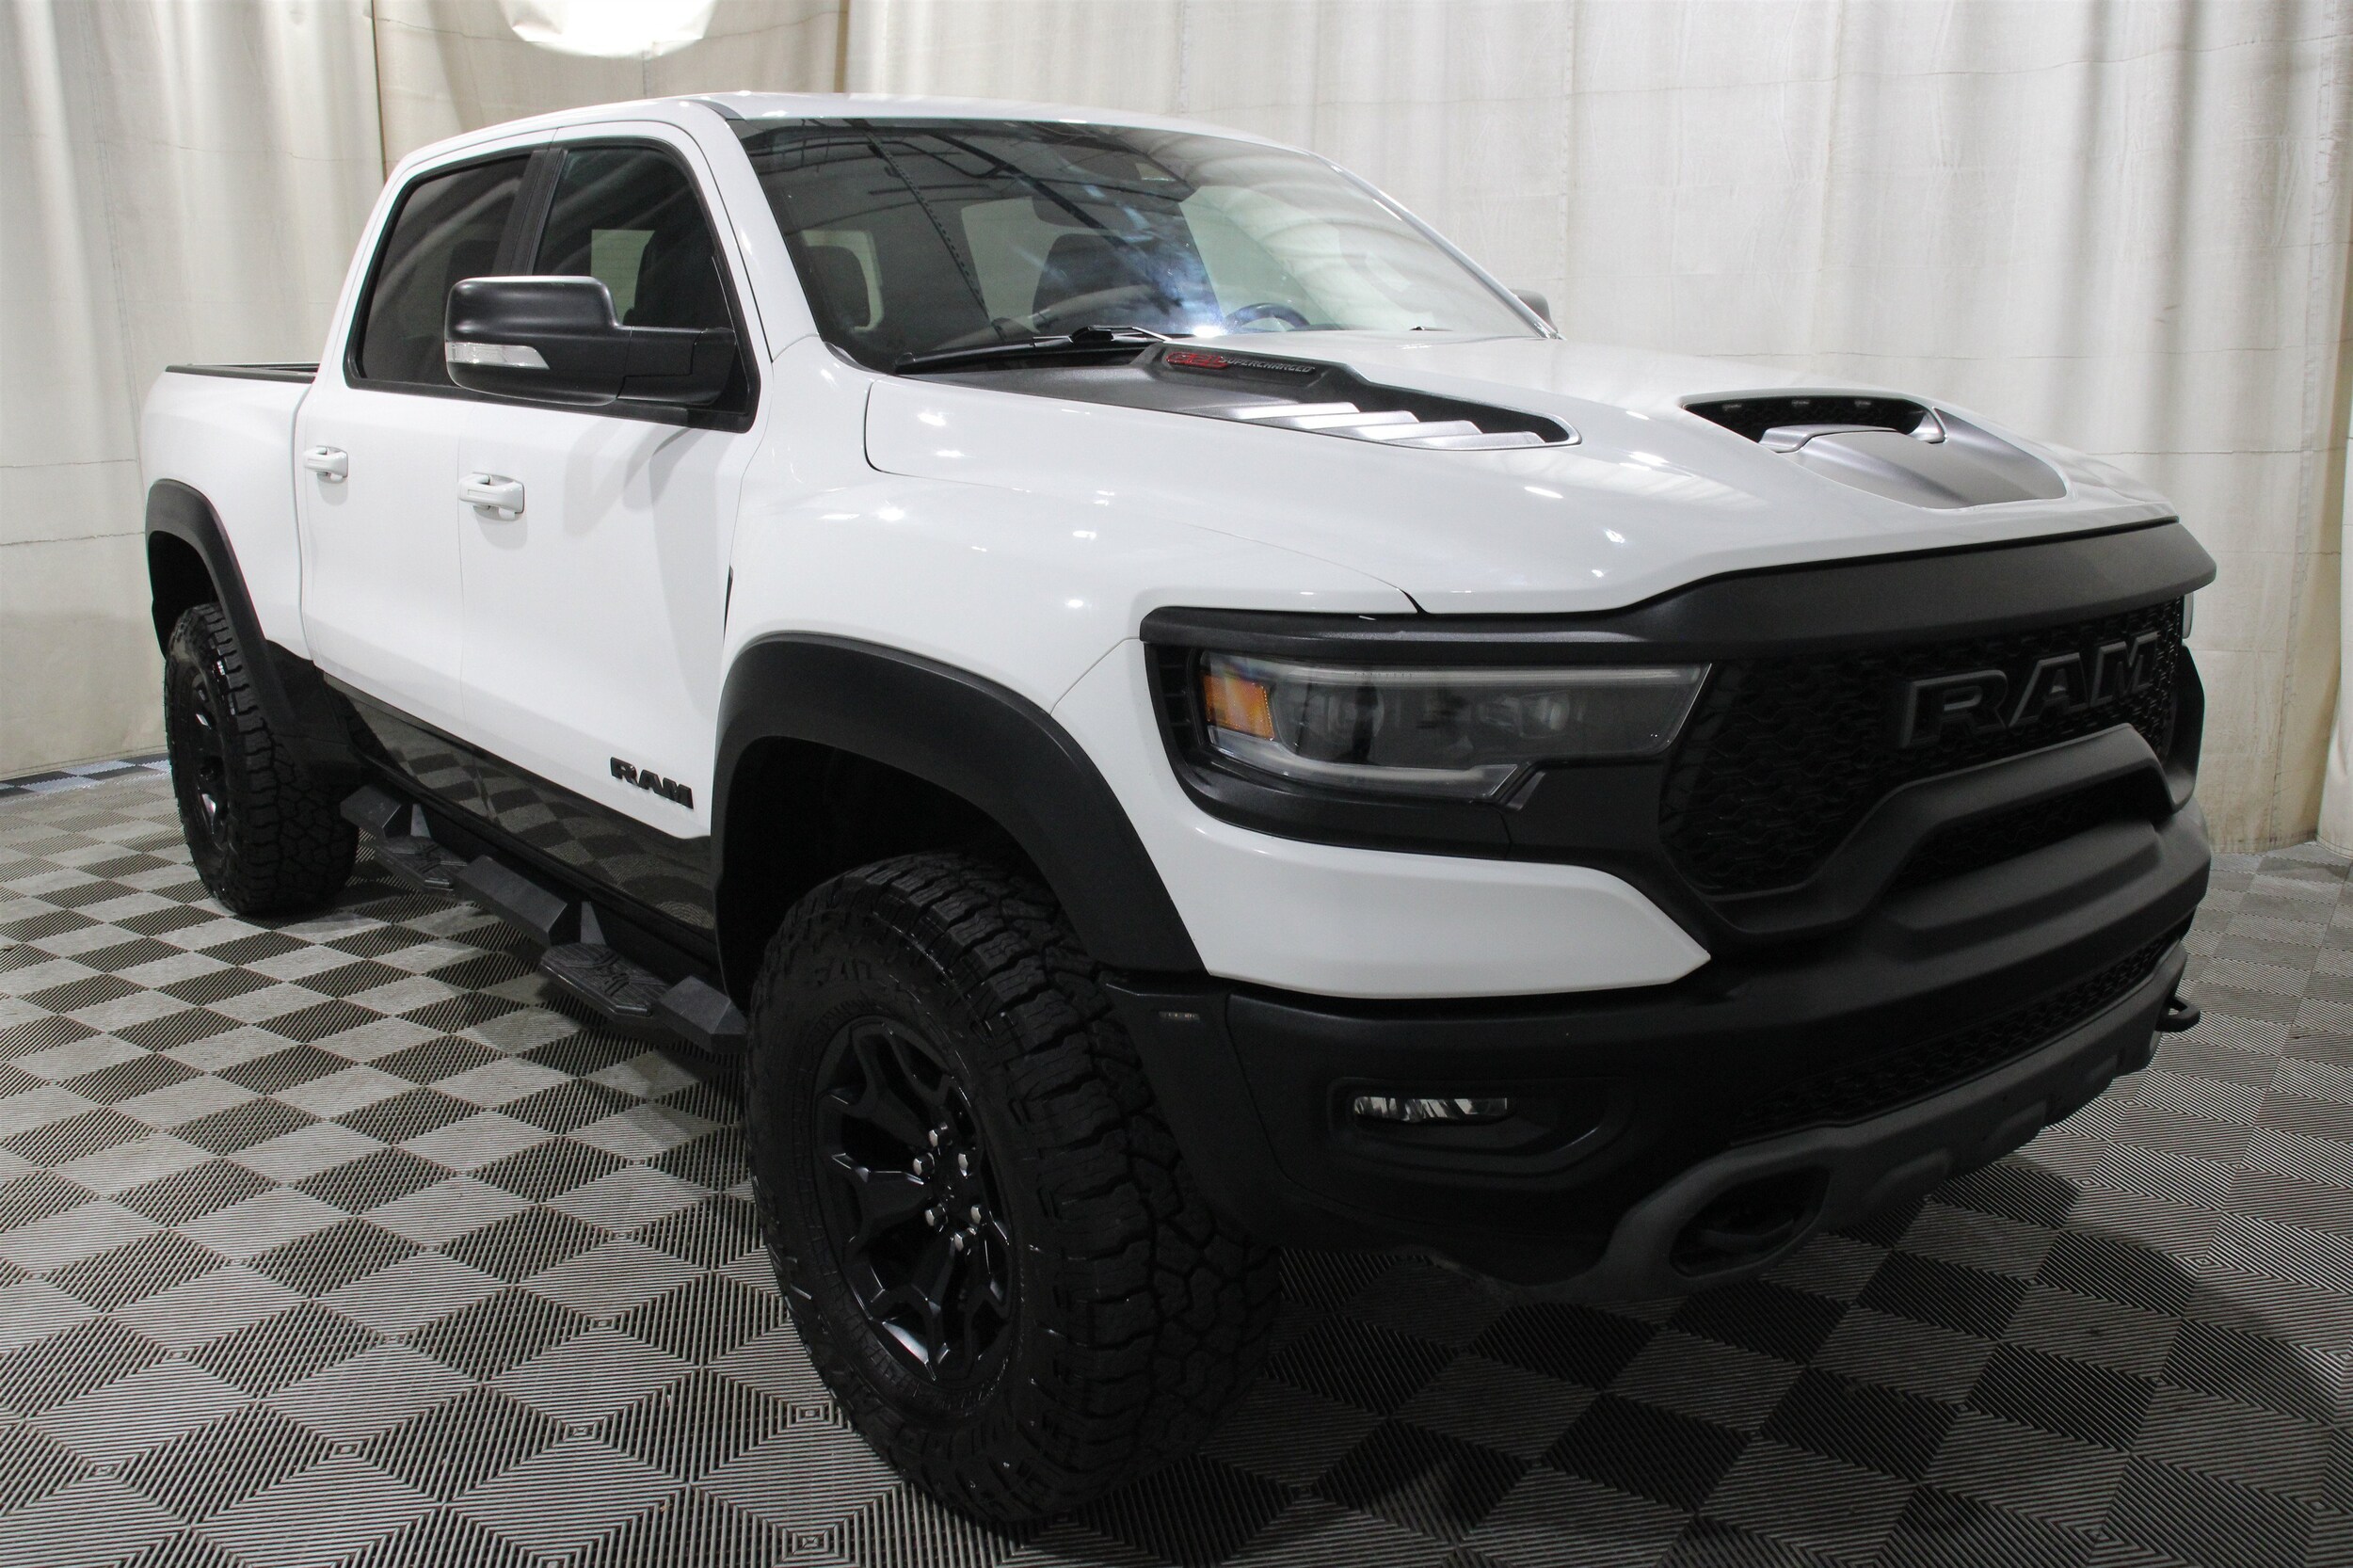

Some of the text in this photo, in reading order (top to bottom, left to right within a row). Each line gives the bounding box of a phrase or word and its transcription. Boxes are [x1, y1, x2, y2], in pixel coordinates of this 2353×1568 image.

[1220, 357, 1315, 373] SUPERCHARGED
[1899, 631, 2161, 749] RAM
[610, 757, 694, 809] RAM
